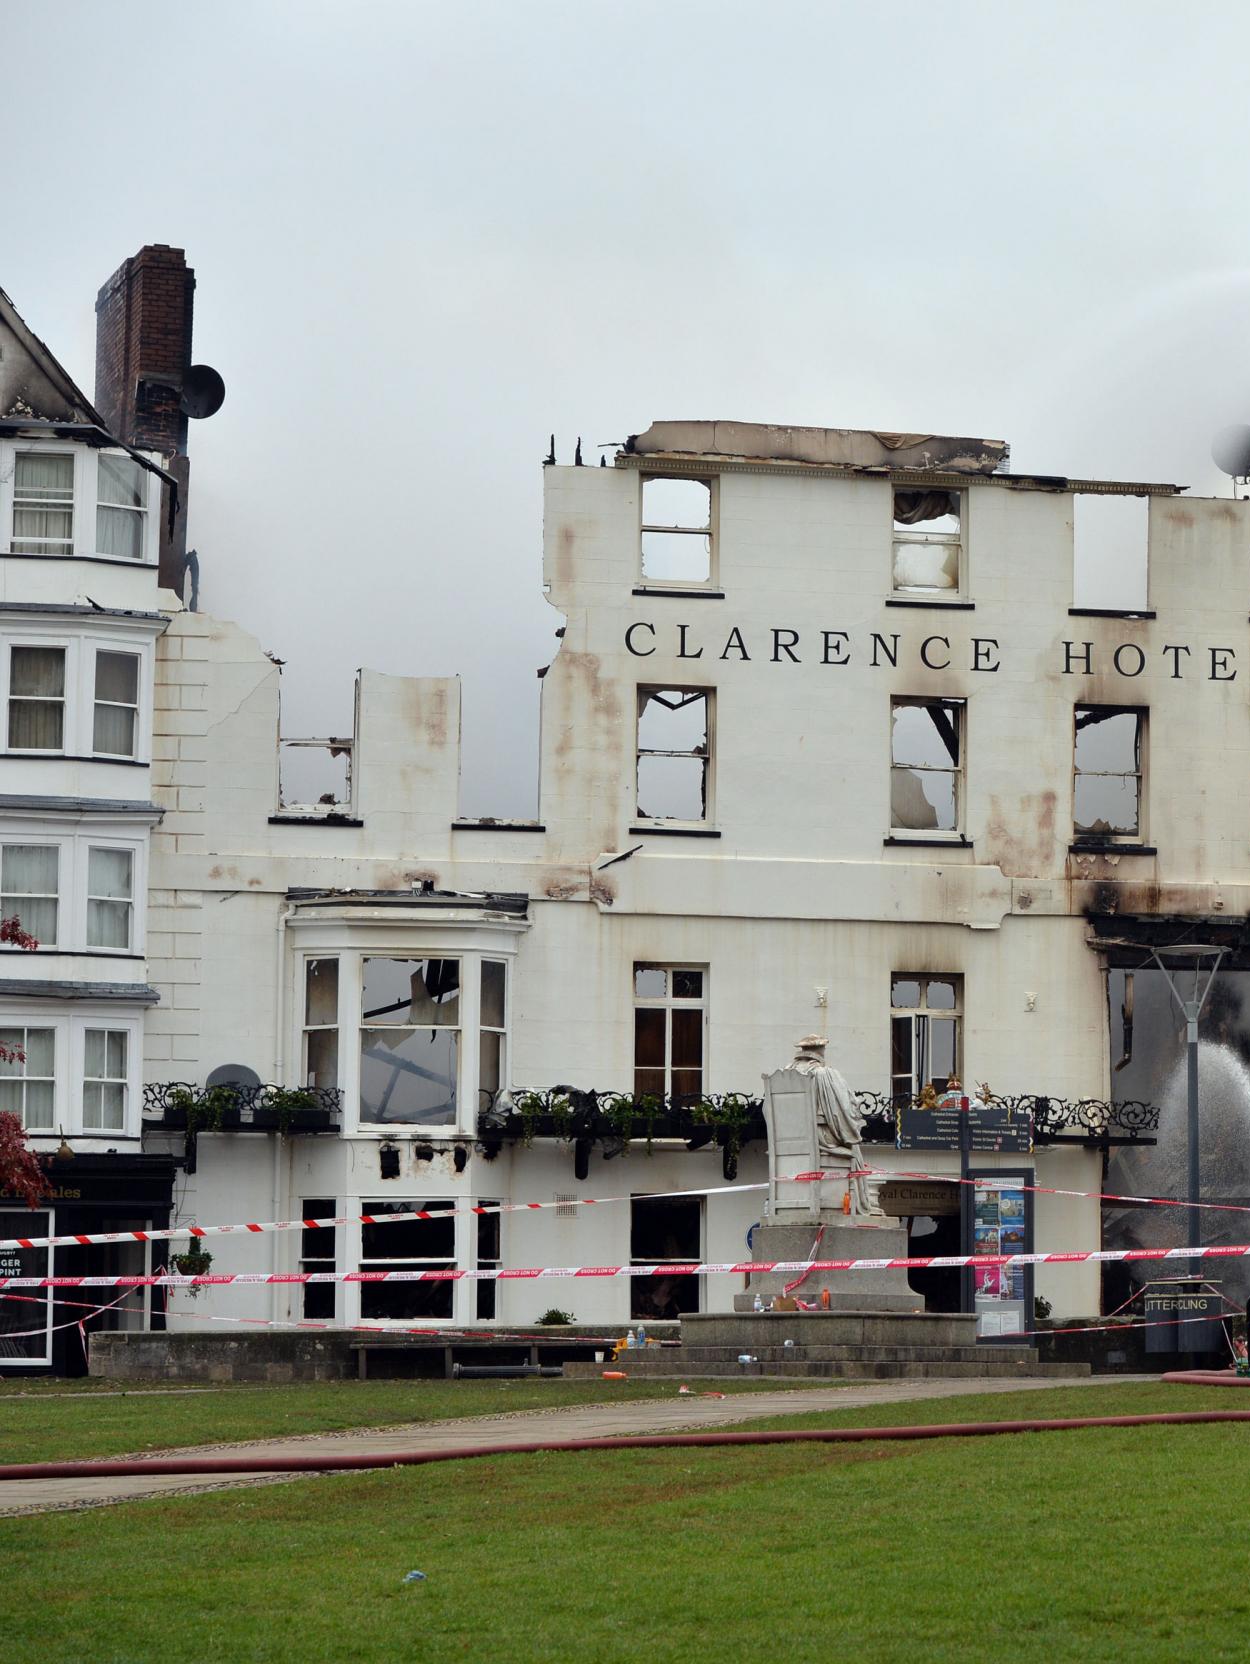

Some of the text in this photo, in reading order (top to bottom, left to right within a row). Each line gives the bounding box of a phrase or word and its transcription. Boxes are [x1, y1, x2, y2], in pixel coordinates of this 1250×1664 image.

[624, 622, 1001, 672] CLARENCE
[878, 1188, 897, 1200] yal
[900, 1188, 946, 1200] Clarence
